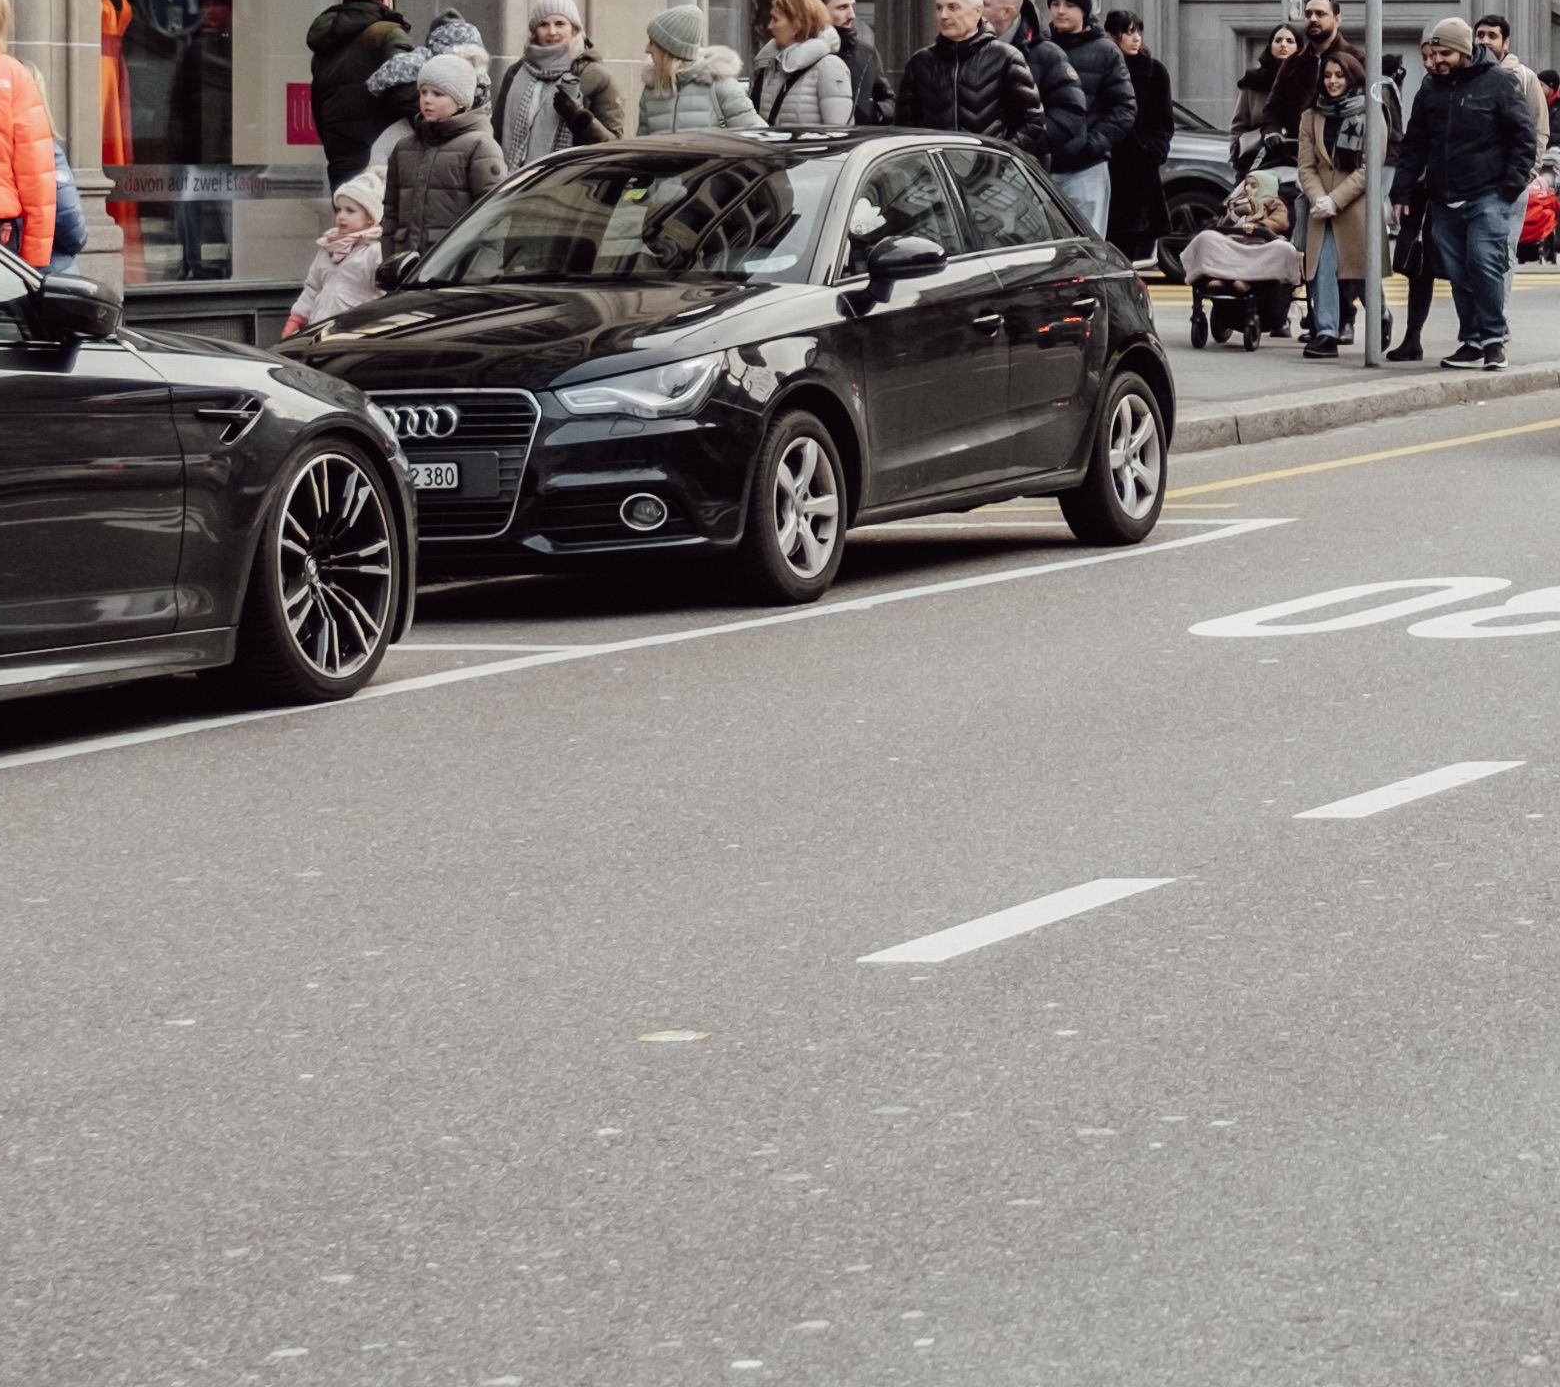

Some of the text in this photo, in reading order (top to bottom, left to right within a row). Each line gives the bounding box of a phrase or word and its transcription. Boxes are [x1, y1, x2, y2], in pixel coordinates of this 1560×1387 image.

[124, 173, 164, 193] davon
[193, 173, 223, 193] zwei
[424, 466, 455, 487] 380
